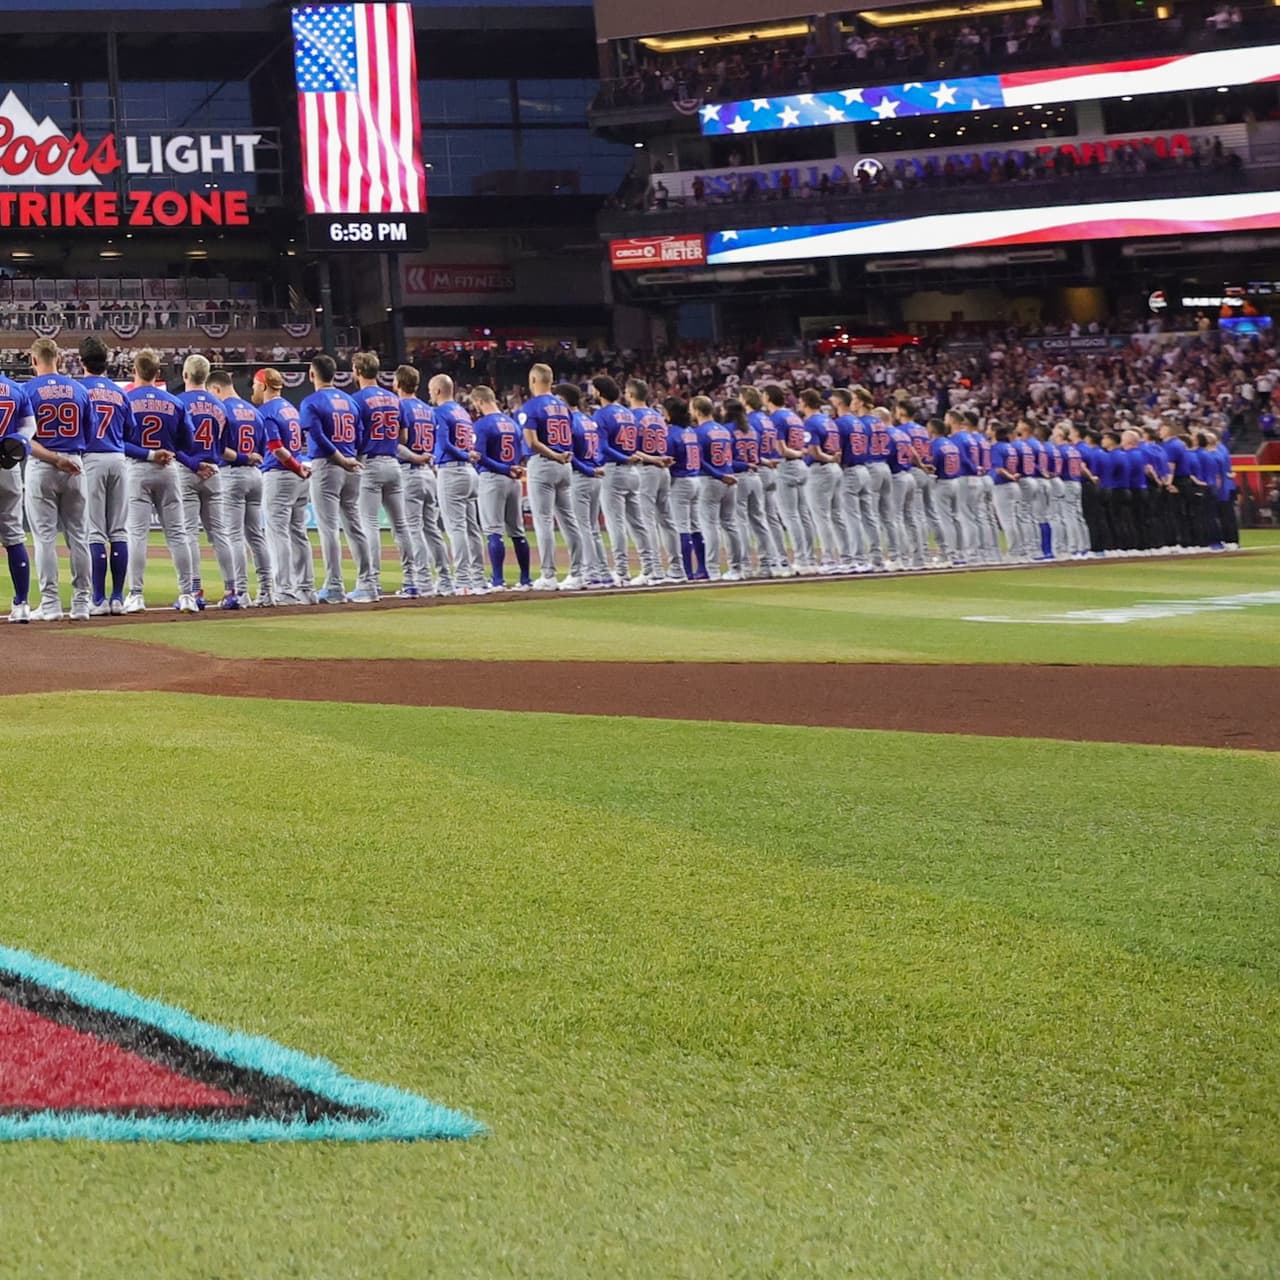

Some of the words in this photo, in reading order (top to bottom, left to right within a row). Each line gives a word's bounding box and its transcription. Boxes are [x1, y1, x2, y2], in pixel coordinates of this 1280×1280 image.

[126, 135, 262, 173] LIGHT
[129, 190, 249, 225] ZONE
[330, 223, 373, 241] 6:58
[379, 223, 407, 241] PM
[36, 402, 79, 438] 29
[96, 404, 115, 439] 7
[141, 415, 162, 448] 2
[193, 418, 214, 450] 4
[289, 420, 300, 452] 3
[331, 411, 355, 443] 16
[370, 410, 400, 441] 25
[546, 418, 573, 446] 50
[239, 424, 255, 455] 6
[411, 422, 435, 452] 15
[499, 434, 516, 462] 5
